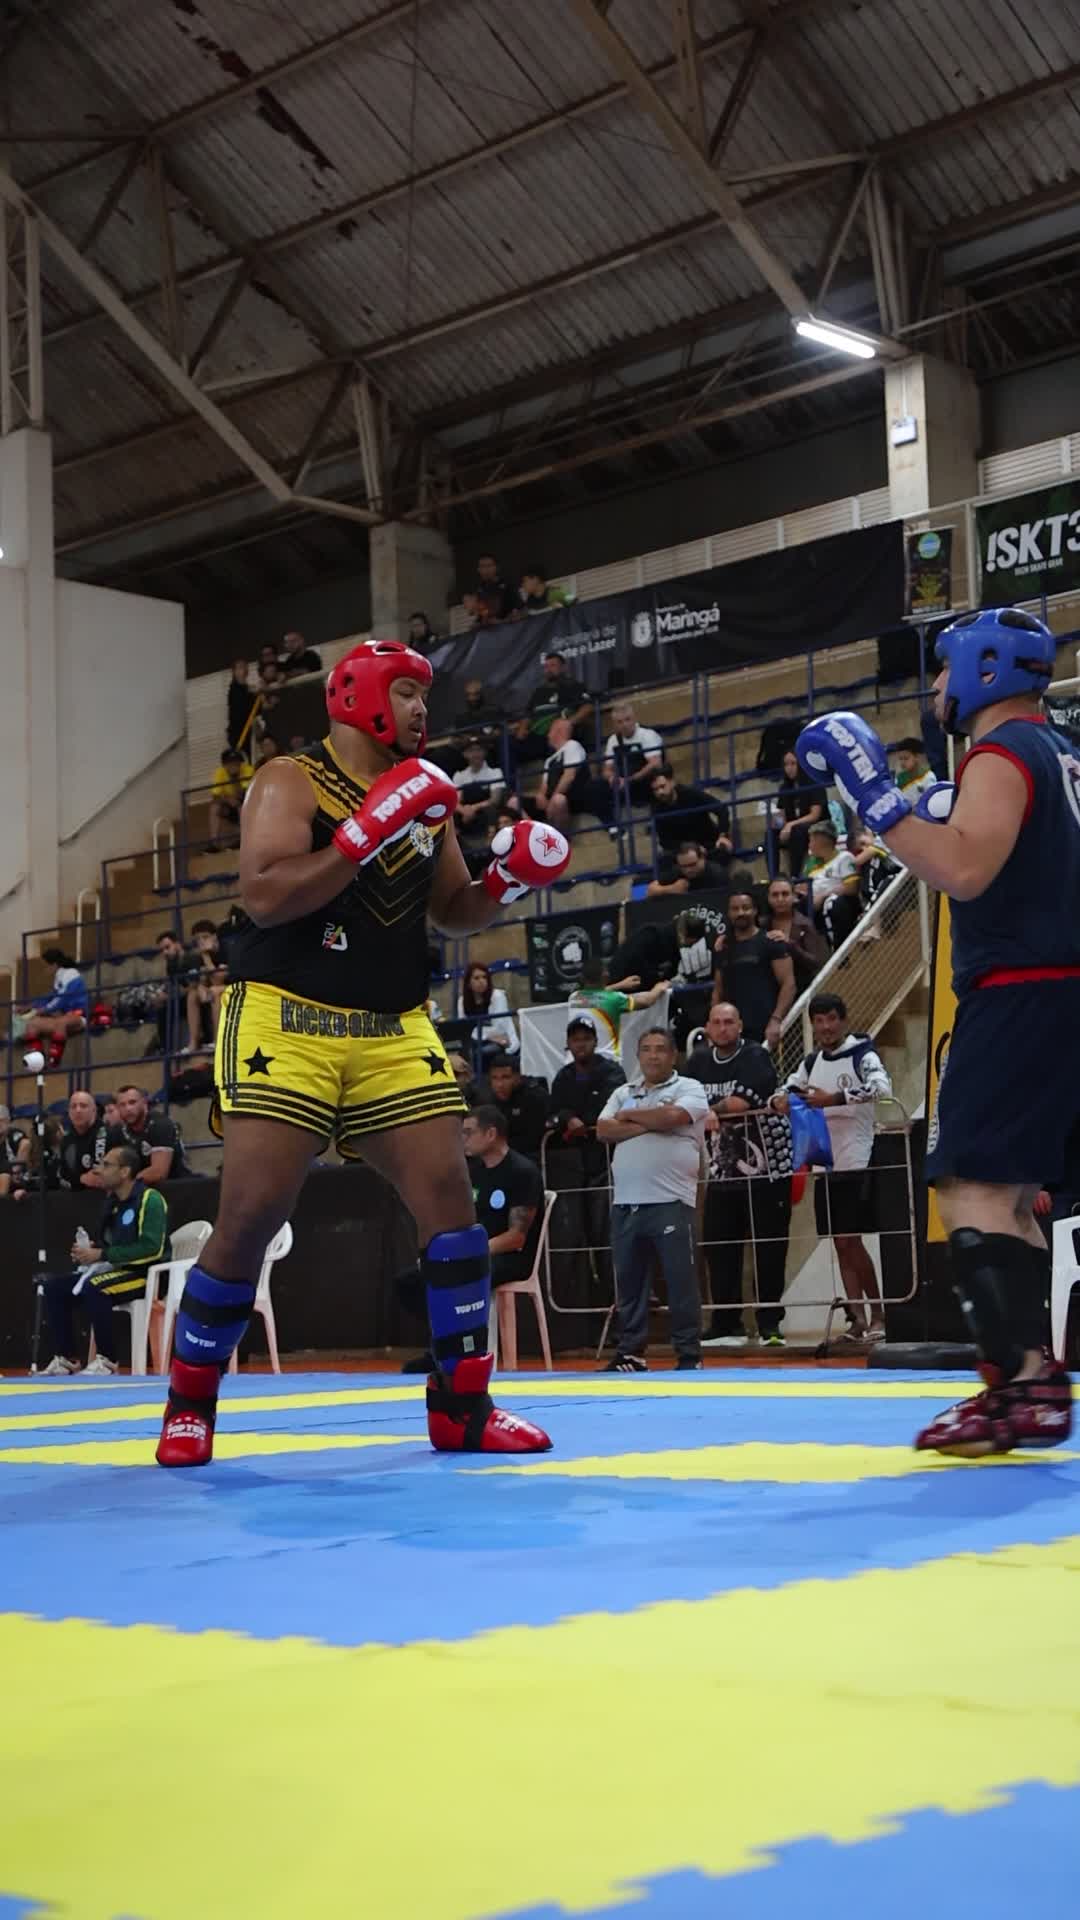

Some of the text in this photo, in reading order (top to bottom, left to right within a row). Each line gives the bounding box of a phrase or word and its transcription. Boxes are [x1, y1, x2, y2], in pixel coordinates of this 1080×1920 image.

[656, 601, 720, 634] Maringá
[588, 638, 616, 653] Lazer
[823, 719, 879, 784] TOP TEN
[371, 773, 434, 824] TOP TEN
[455, 1299, 485, 1315] TOP TEN
[185, 1330, 217, 1348] TOP TEN
[167, 1422, 207, 1438] TOP TEN
